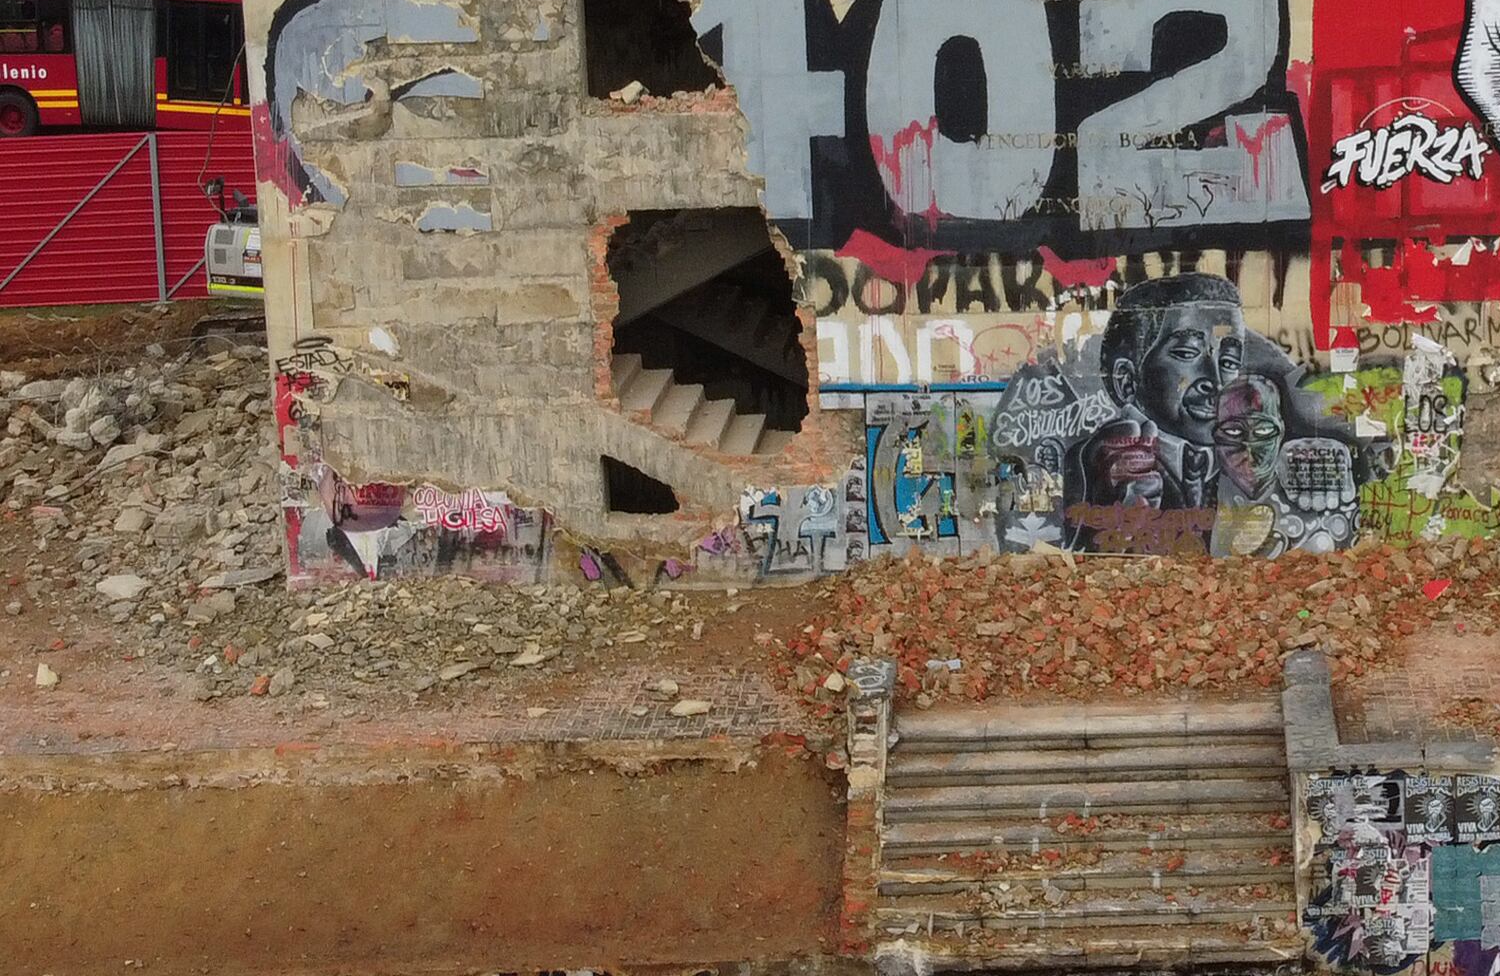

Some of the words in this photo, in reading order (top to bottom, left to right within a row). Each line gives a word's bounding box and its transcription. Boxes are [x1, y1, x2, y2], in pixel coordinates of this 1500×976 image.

[1328, 114, 1488, 186] FUERZA
[1355, 321, 1479, 354] BOLIVAR
[413, 486, 488, 509] COLONIA
